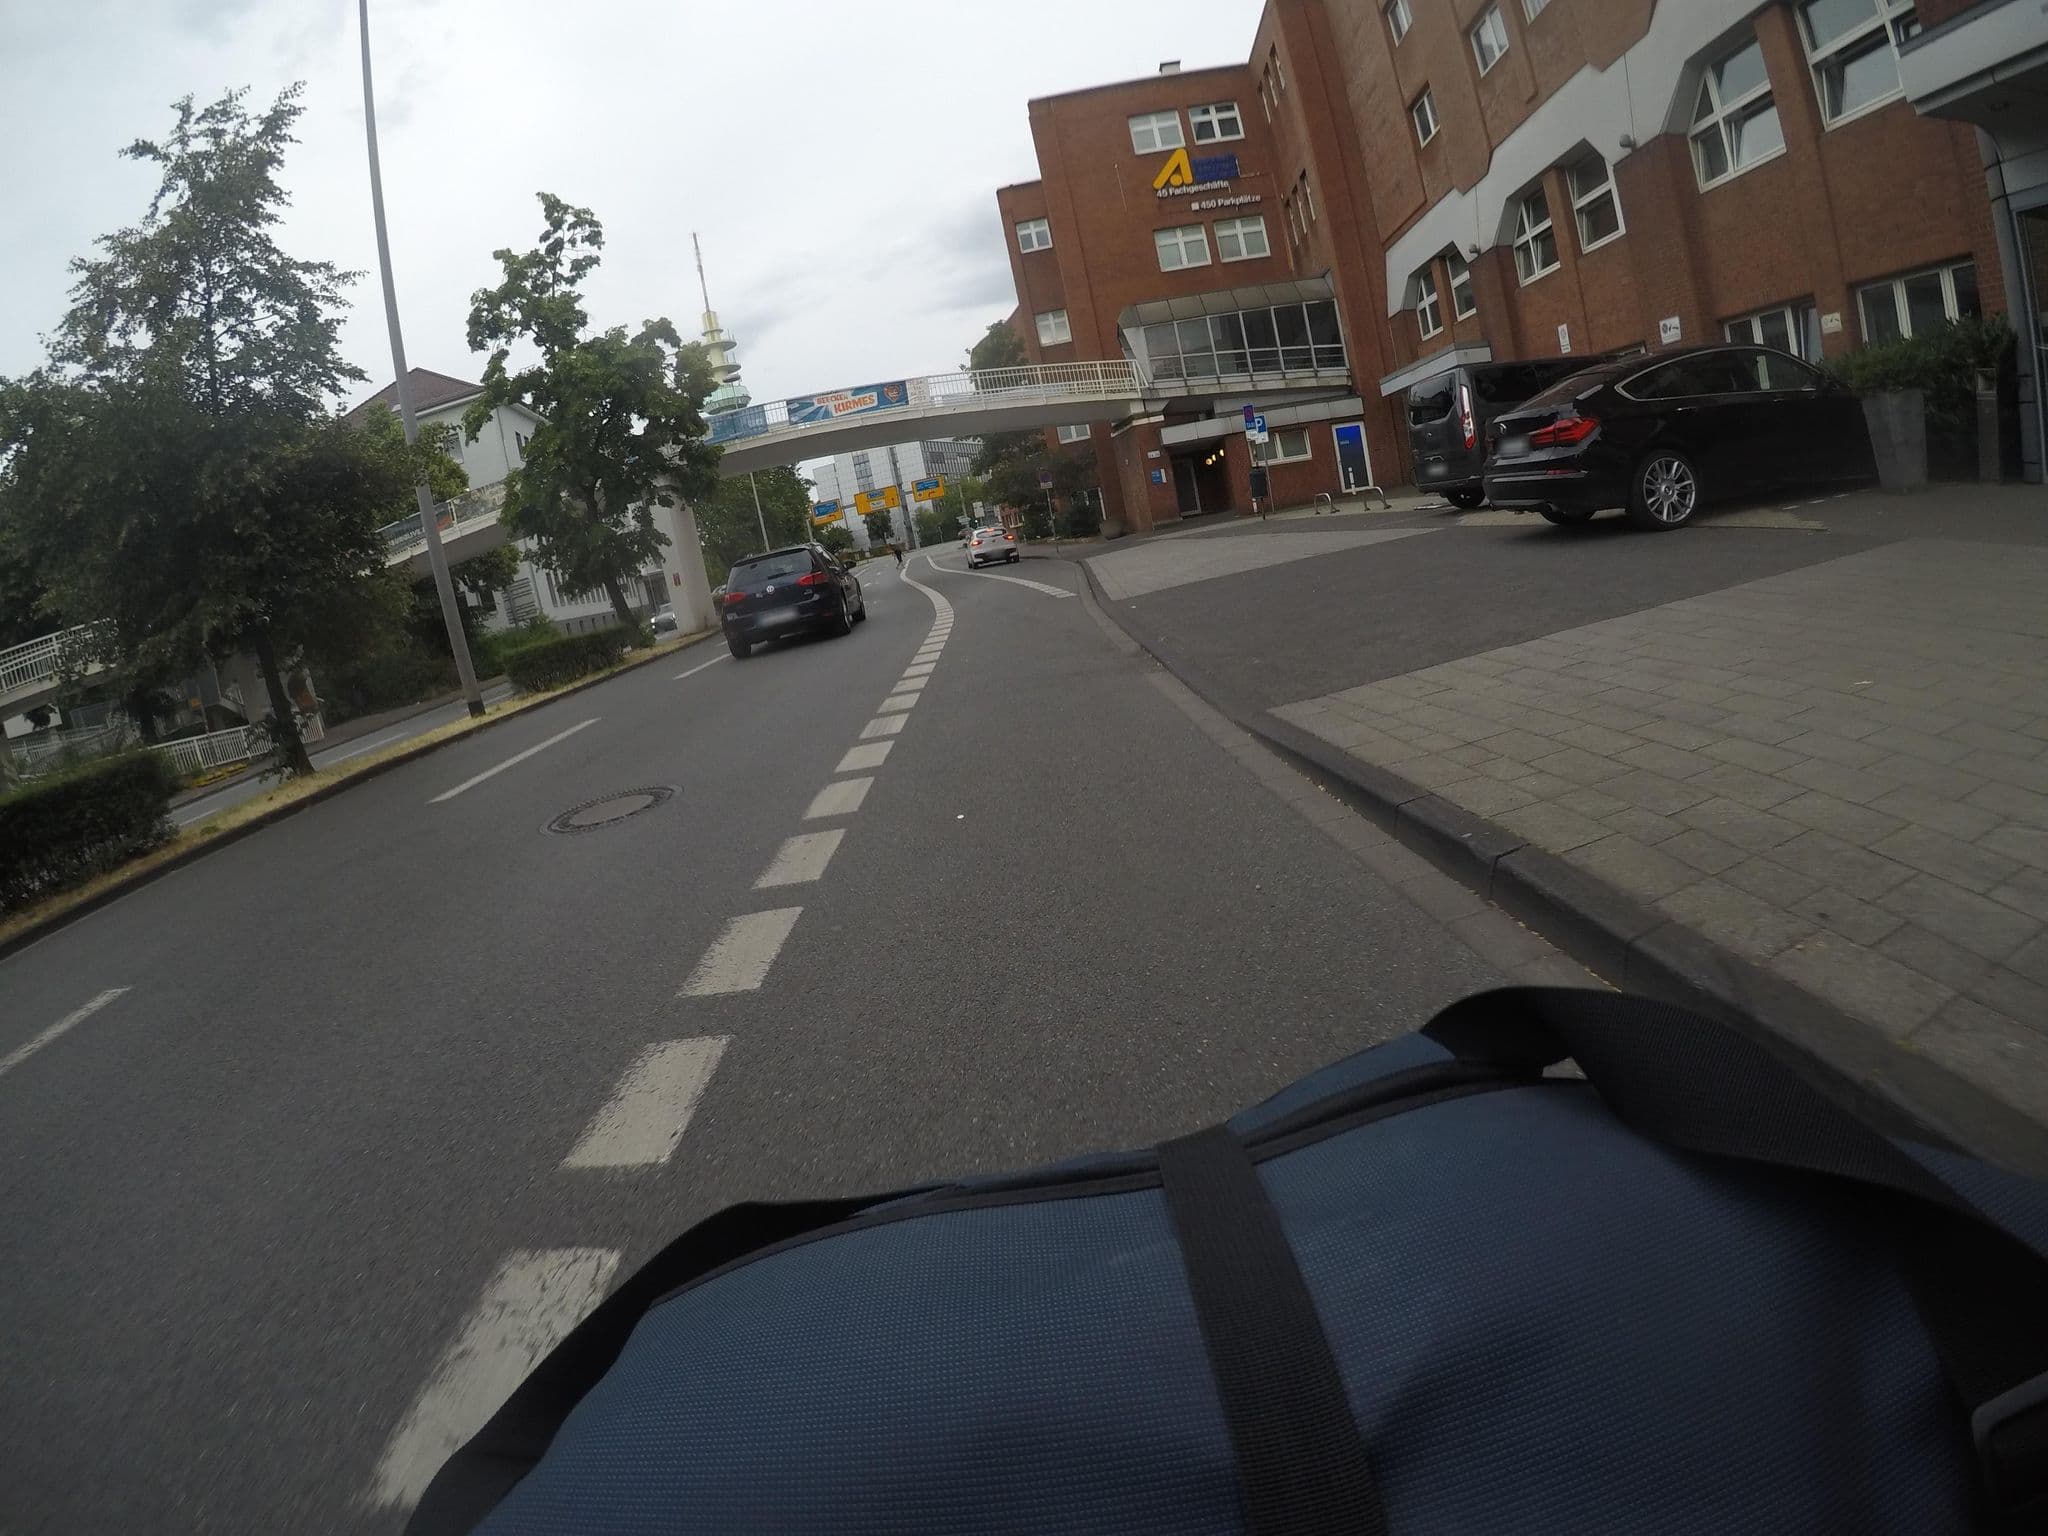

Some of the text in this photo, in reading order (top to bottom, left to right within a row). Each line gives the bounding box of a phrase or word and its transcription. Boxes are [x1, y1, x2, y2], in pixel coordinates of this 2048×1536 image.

[1169, 179, 1229, 196] Fachgeschäfte
[1200, 194, 1261, 210] 450 Parkplätze
[834, 394, 876, 414] KIRMES
